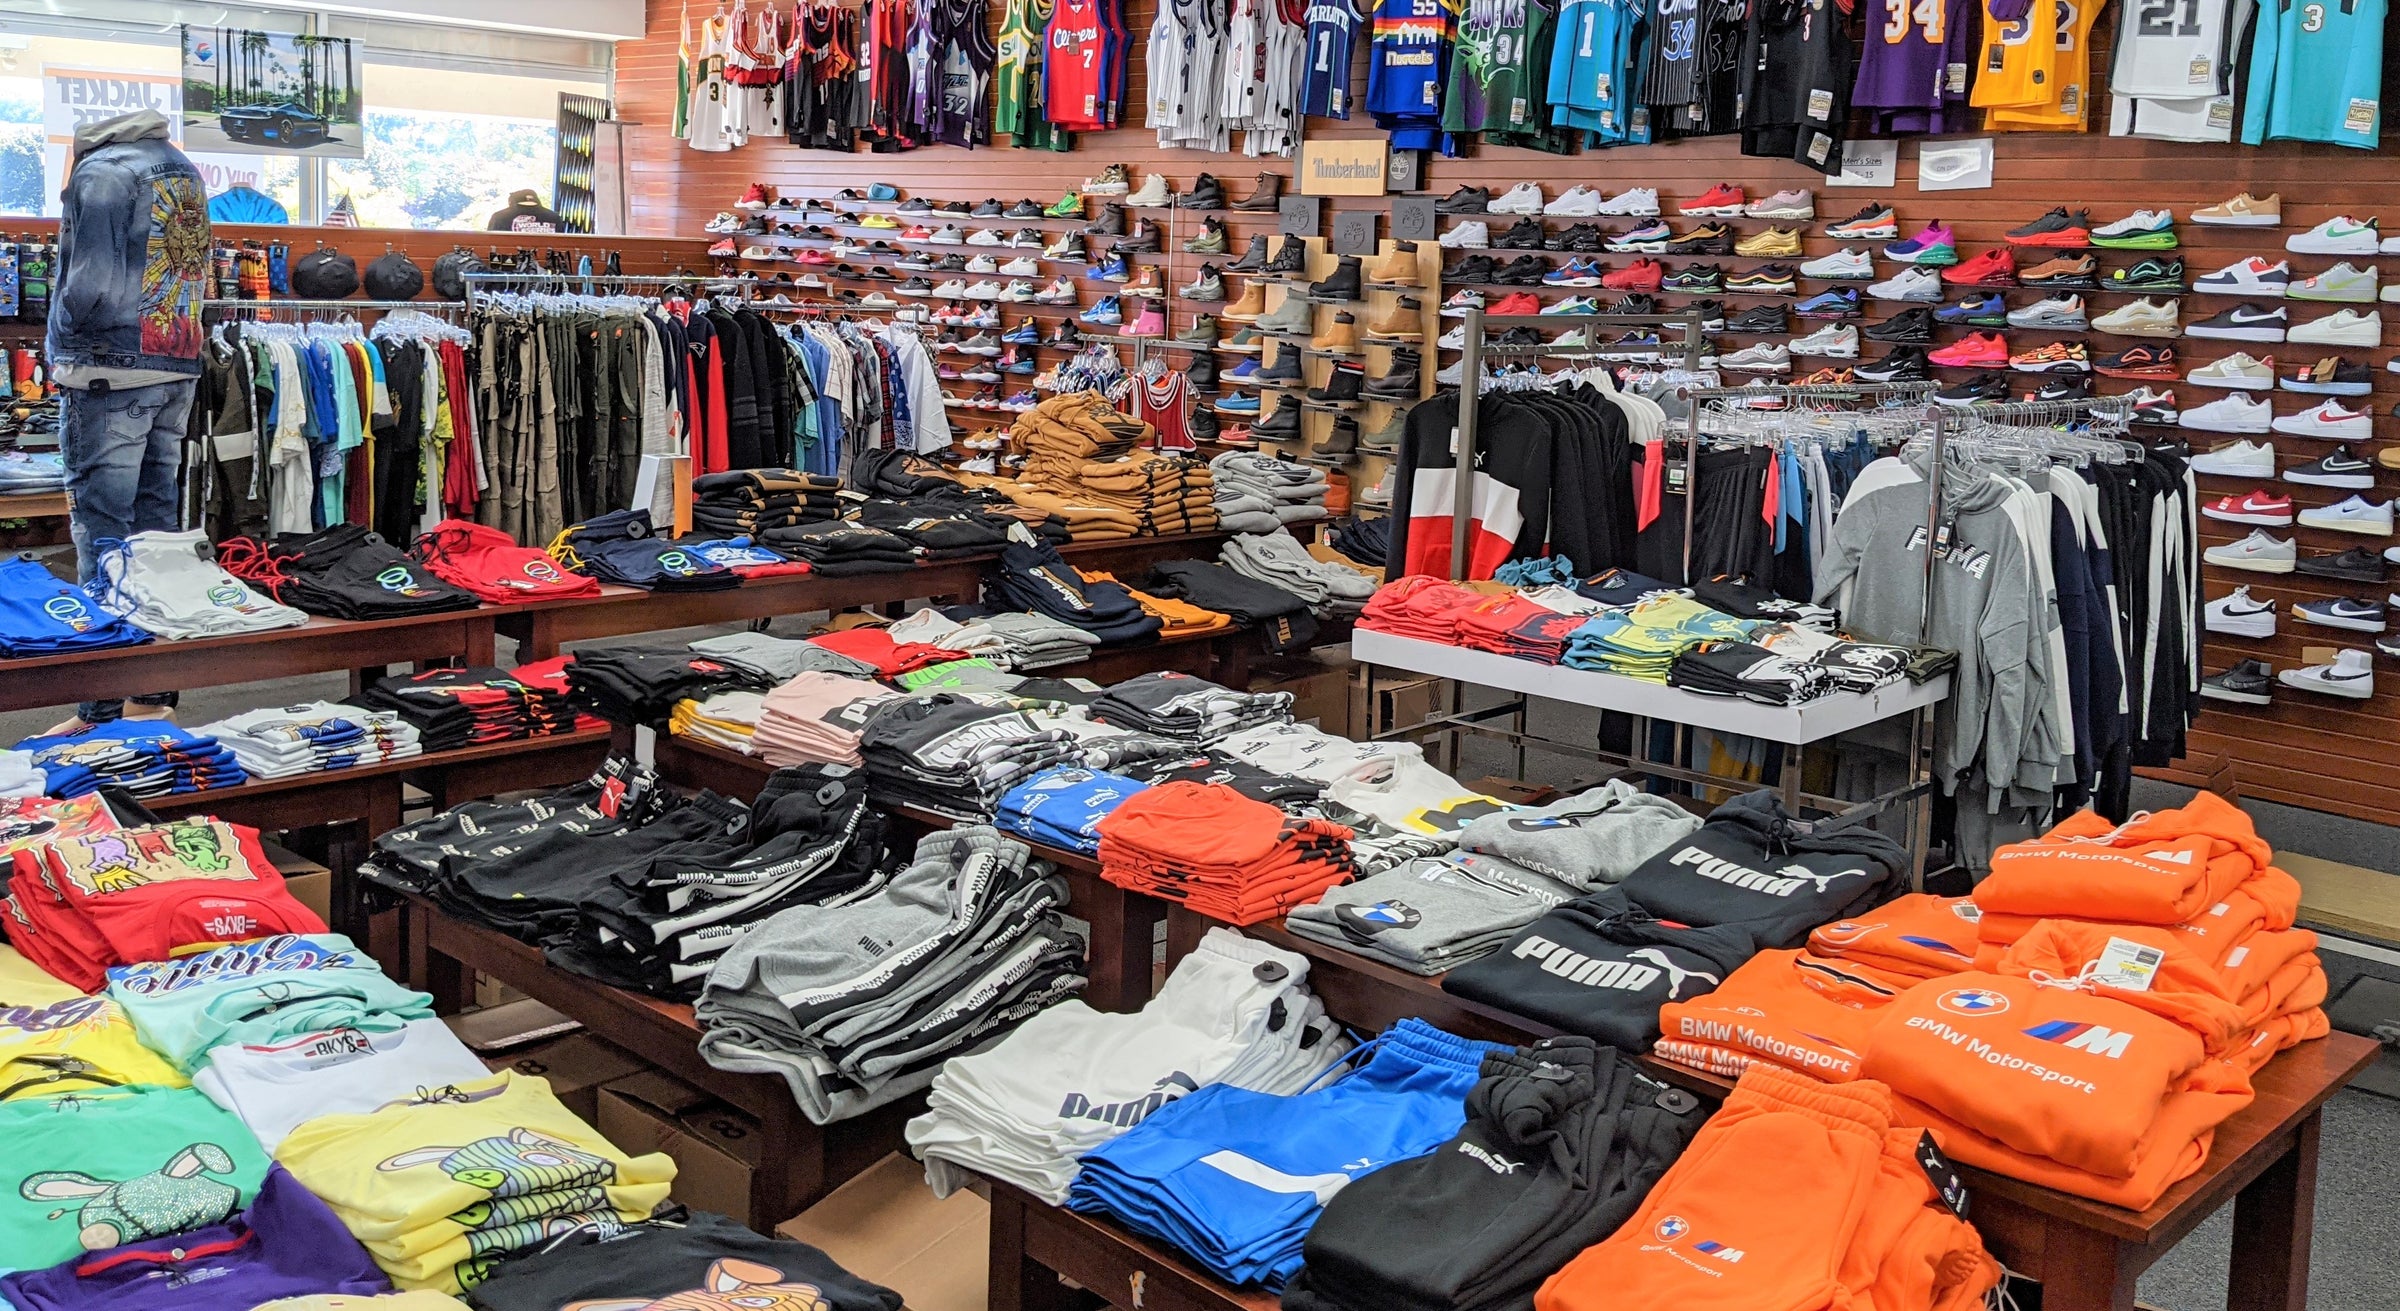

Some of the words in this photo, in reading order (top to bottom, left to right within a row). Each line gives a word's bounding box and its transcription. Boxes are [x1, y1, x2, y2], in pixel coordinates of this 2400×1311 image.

[1580, 12, 1596, 57] 1
[1803, 14, 1811, 41] 3
[1884, 0, 1945, 44] 34
[2137, 0, 2201, 37] 21
[2302, 3, 2325, 33] 3
[1315, 30, 1331, 72] 1
[1496, 34, 1525, 66] 34
[1663, 18, 1696, 61] 32
[1710, 31, 1736, 72] 32
[1083, 49, 1094, 68] 7
[709, 82, 719, 101] 3
[943, 94, 969, 116] 32
[1313, 157, 1381, 179] Timberland
[1865, 157, 1883, 165] Sizes
[1905, 525, 1991, 580] PMA
[1668, 846, 1808, 897] PUMA
[1999, 850, 2052, 860] BMW
[2057, 851, 2180, 876] Motorsport
[214, 915, 246, 936] BKYS
[857, 934, 886, 958] PUM
[1512, 936, 1662, 992] PUMA
[316, 1035, 357, 1057] BKYS
[1680, 1017, 1732, 1043] BMW
[1737, 1025, 1852, 1073] Motorsport
[1904, 1016, 1968, 1046] BMW
[1966, 1038, 2096, 1094] Motorsport
[1058, 1092, 1180, 1128] PUM
[1458, 1141, 1506, 1174] PUMA
